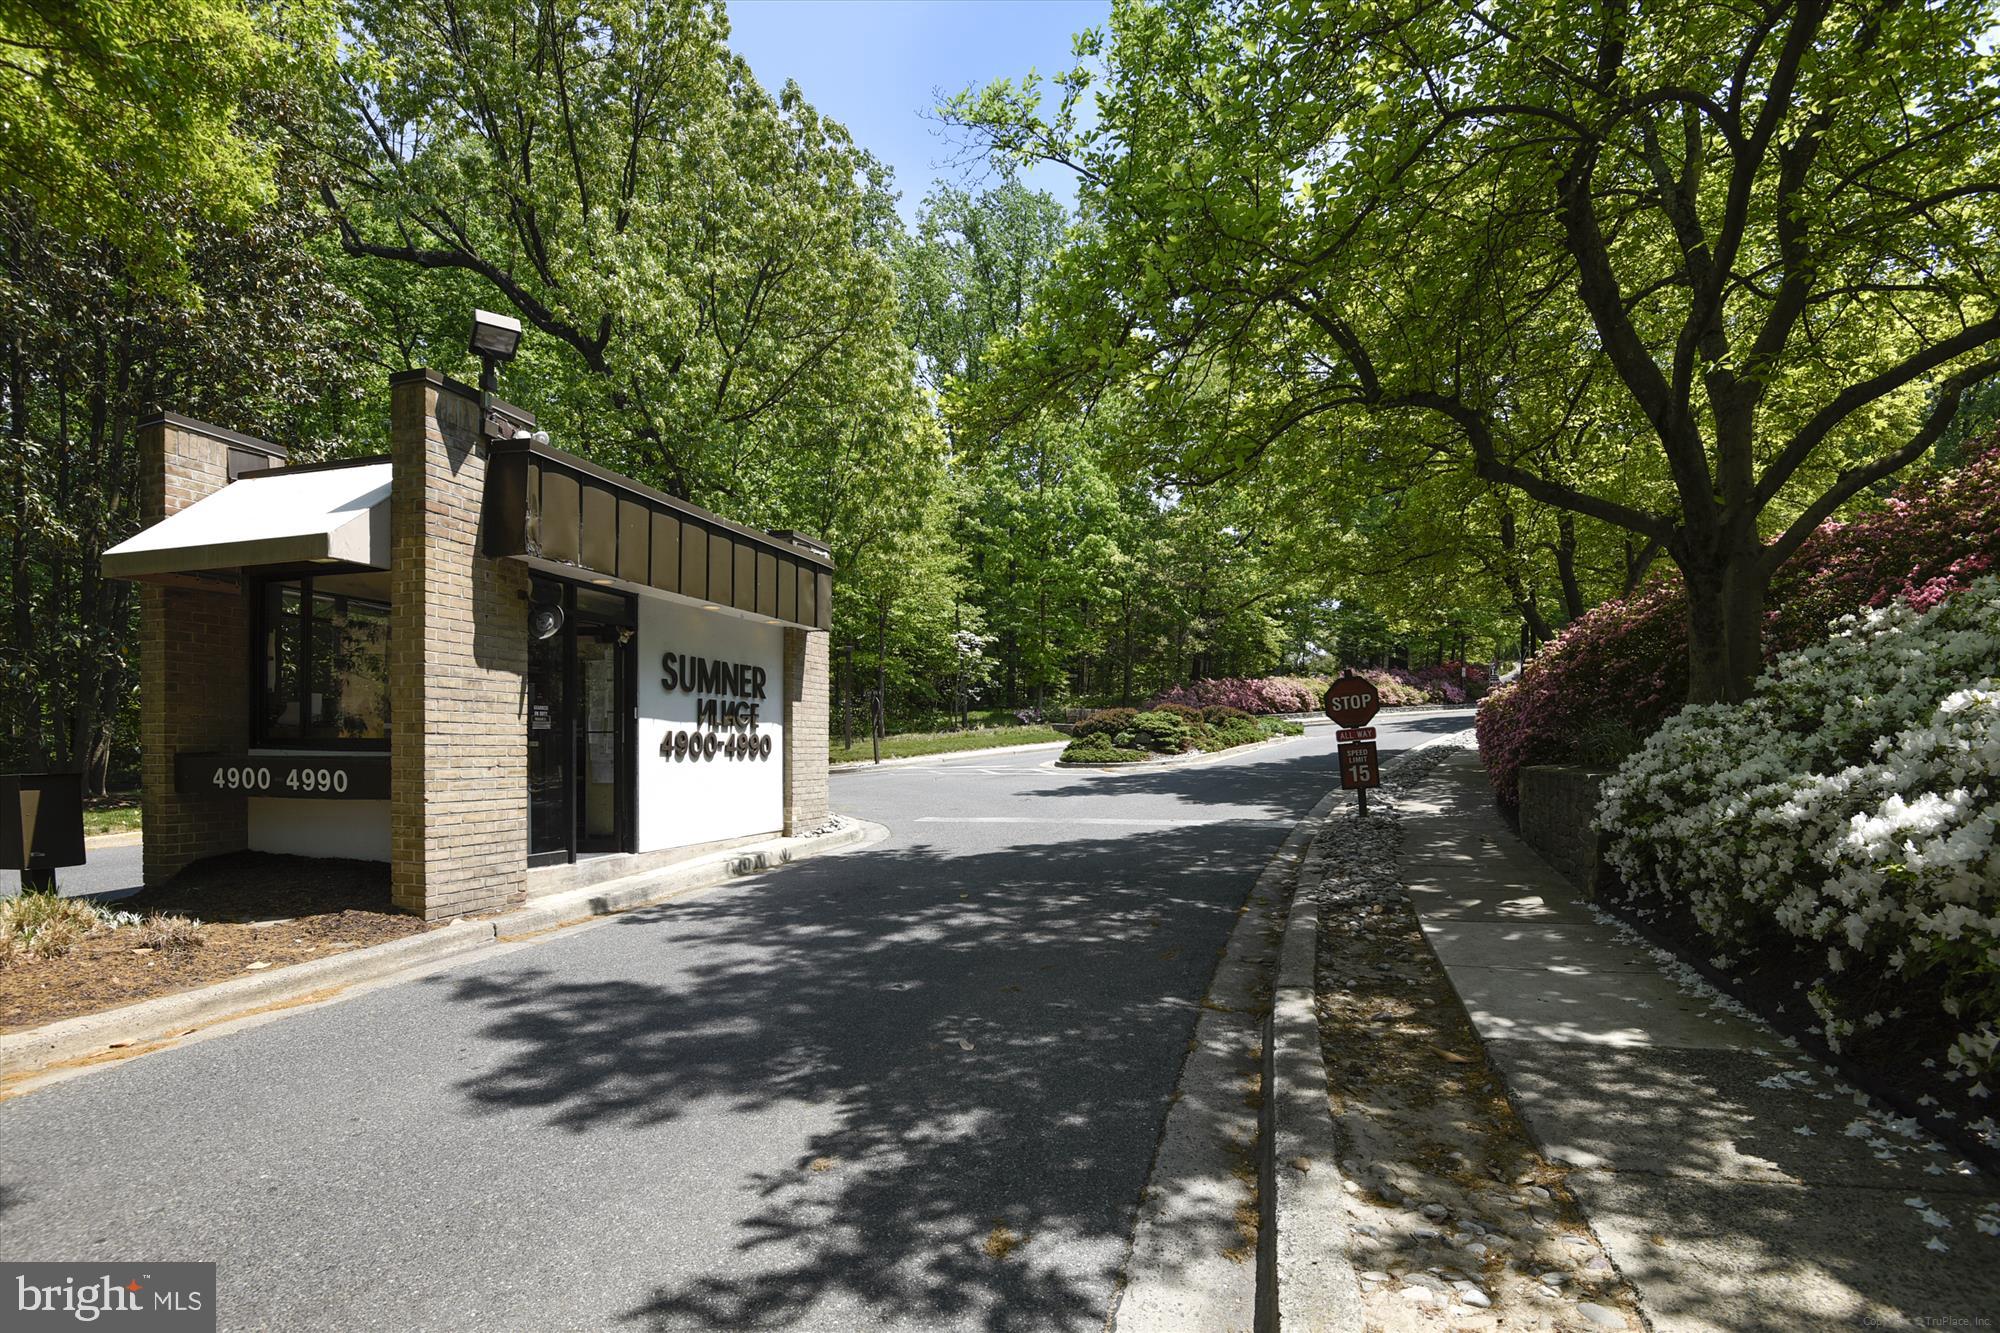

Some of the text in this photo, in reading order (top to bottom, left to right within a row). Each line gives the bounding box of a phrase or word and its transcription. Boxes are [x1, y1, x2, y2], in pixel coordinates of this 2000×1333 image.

[661, 652, 767, 699] SUMNER
[1332, 693, 1372, 712] STOP
[1340, 729, 1373, 740] ALL WAY
[659, 731, 772, 762] 4900-4990
[1346, 749, 1368, 757] SPEED
[1348, 756, 1368, 764] LIMIT
[213, 767, 348, 792] 4900 4990
[1349, 764, 1371, 783] 15
